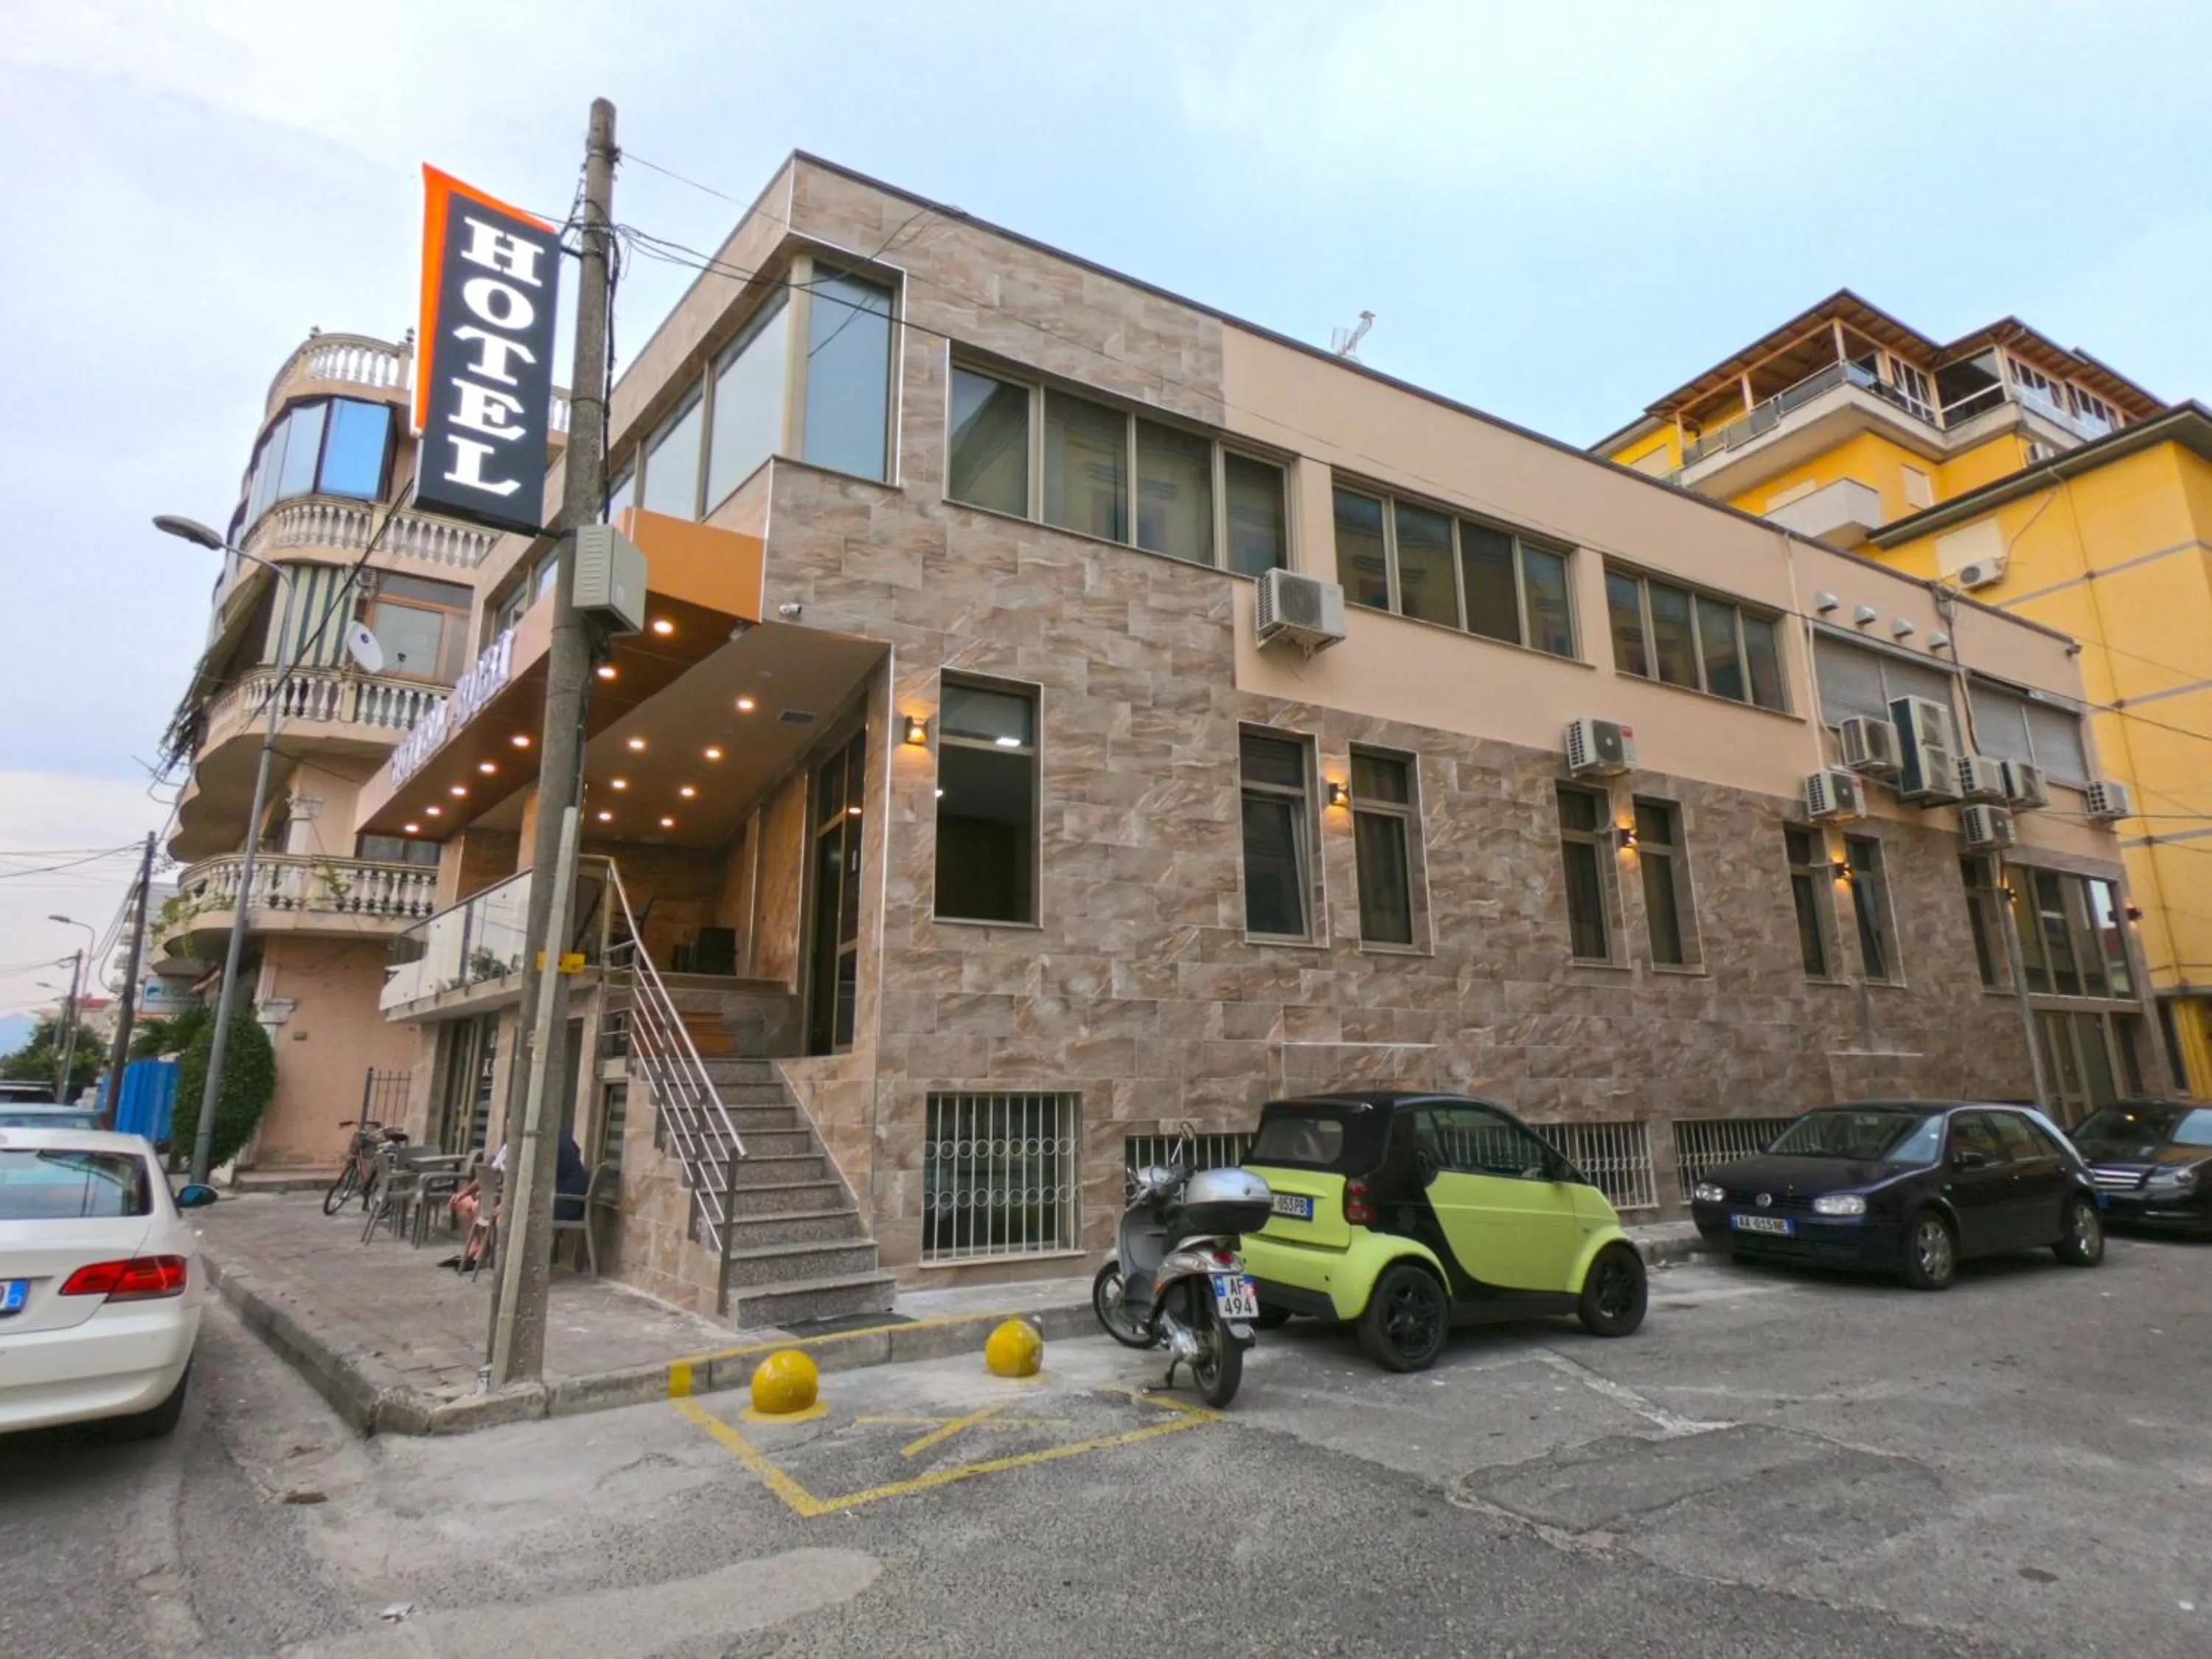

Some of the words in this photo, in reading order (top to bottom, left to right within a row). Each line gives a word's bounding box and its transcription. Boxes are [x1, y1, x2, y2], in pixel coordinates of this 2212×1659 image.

[444, 216, 544, 496] HOTEL
[1231, 1277, 1243, 1295] AF
[1225, 1297, 1252, 1315] 494
